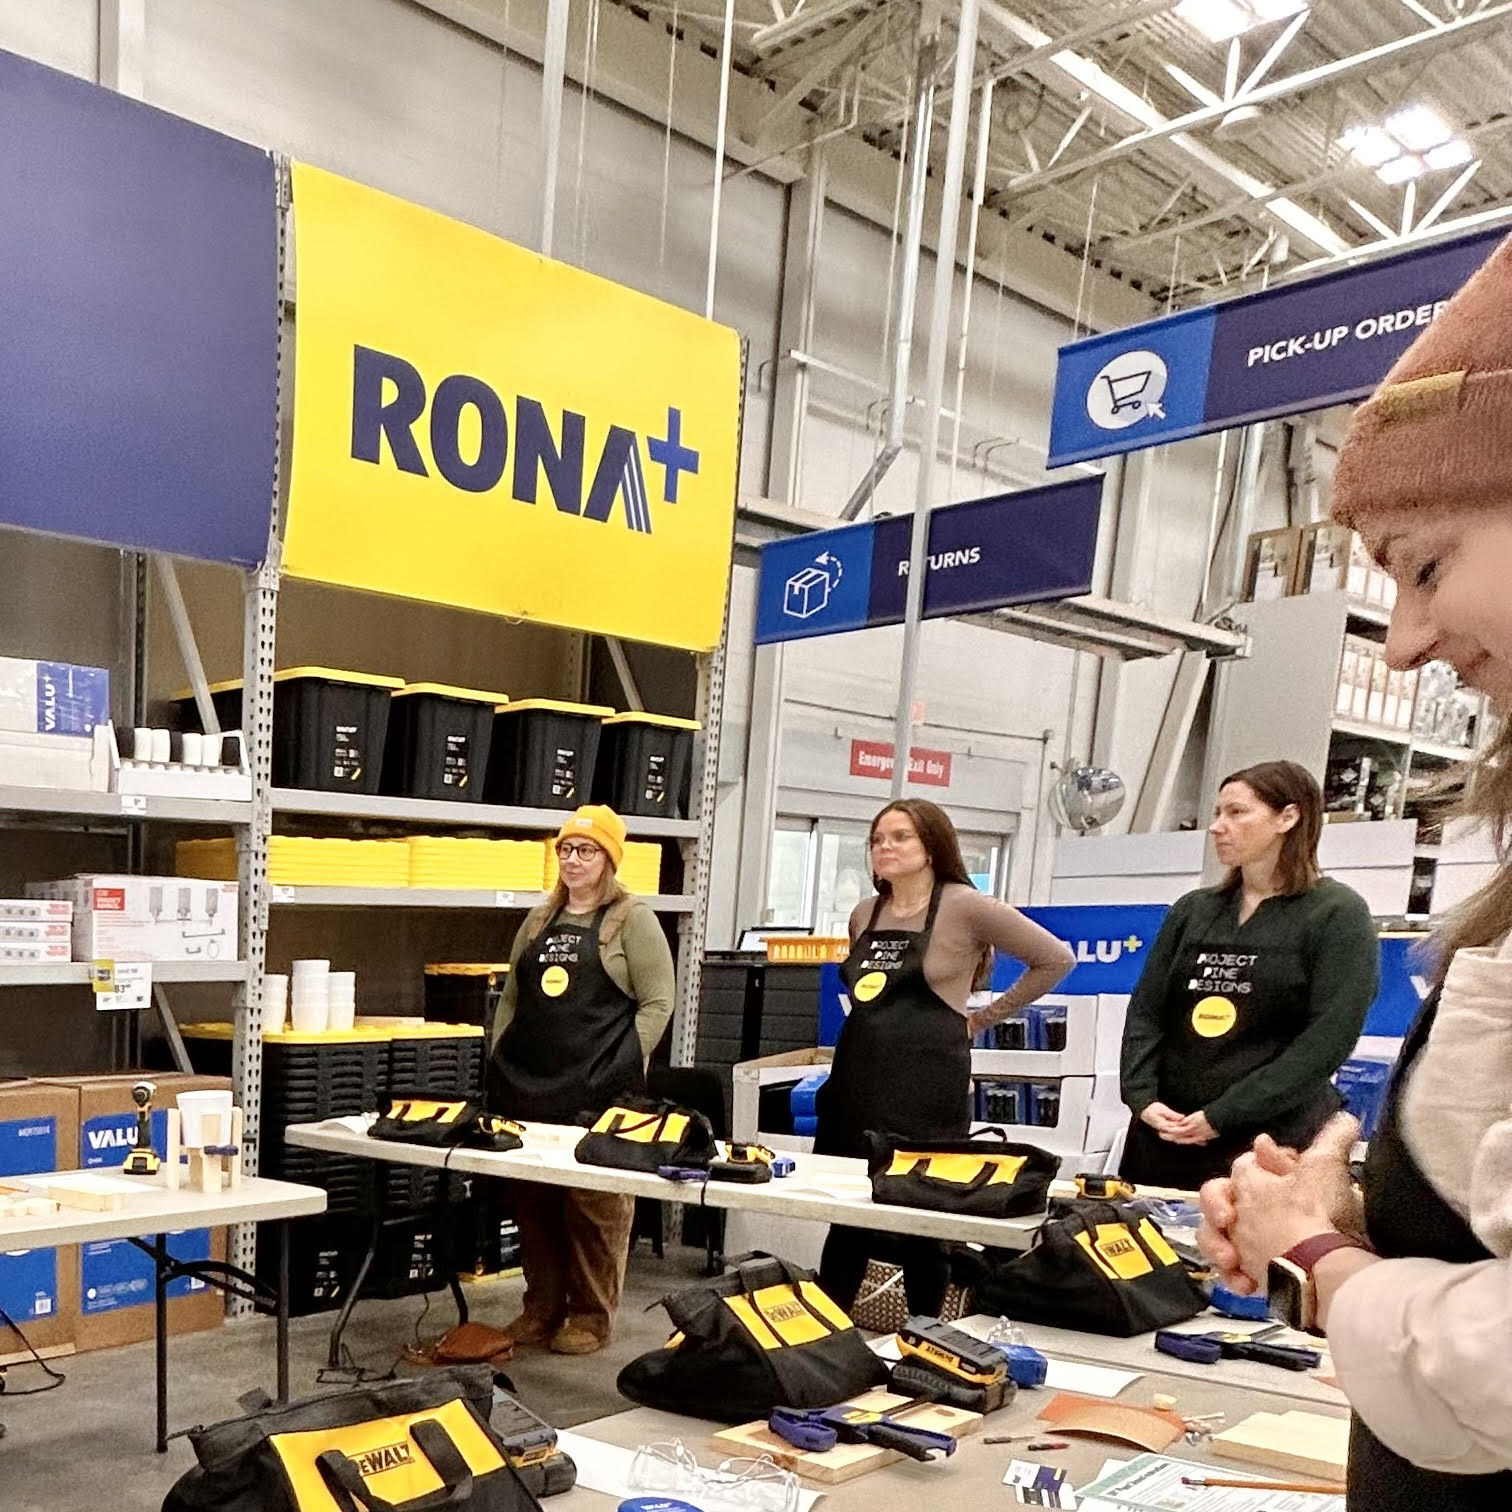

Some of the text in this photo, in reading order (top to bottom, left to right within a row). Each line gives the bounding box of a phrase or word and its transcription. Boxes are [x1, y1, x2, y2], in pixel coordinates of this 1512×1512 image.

[1247, 325, 1348, 367] PICK-UP
[898, 547, 980, 576] RURNS
[927, 760, 944, 779] Only
[1062, 935, 1143, 963] LU+
[1197, 954, 1258, 966] PROJECT
[1203, 967, 1239, 979] PINE
[1188, 979, 1252, 993] DESIGNS
[359, 1444, 410, 1473] EWALT
